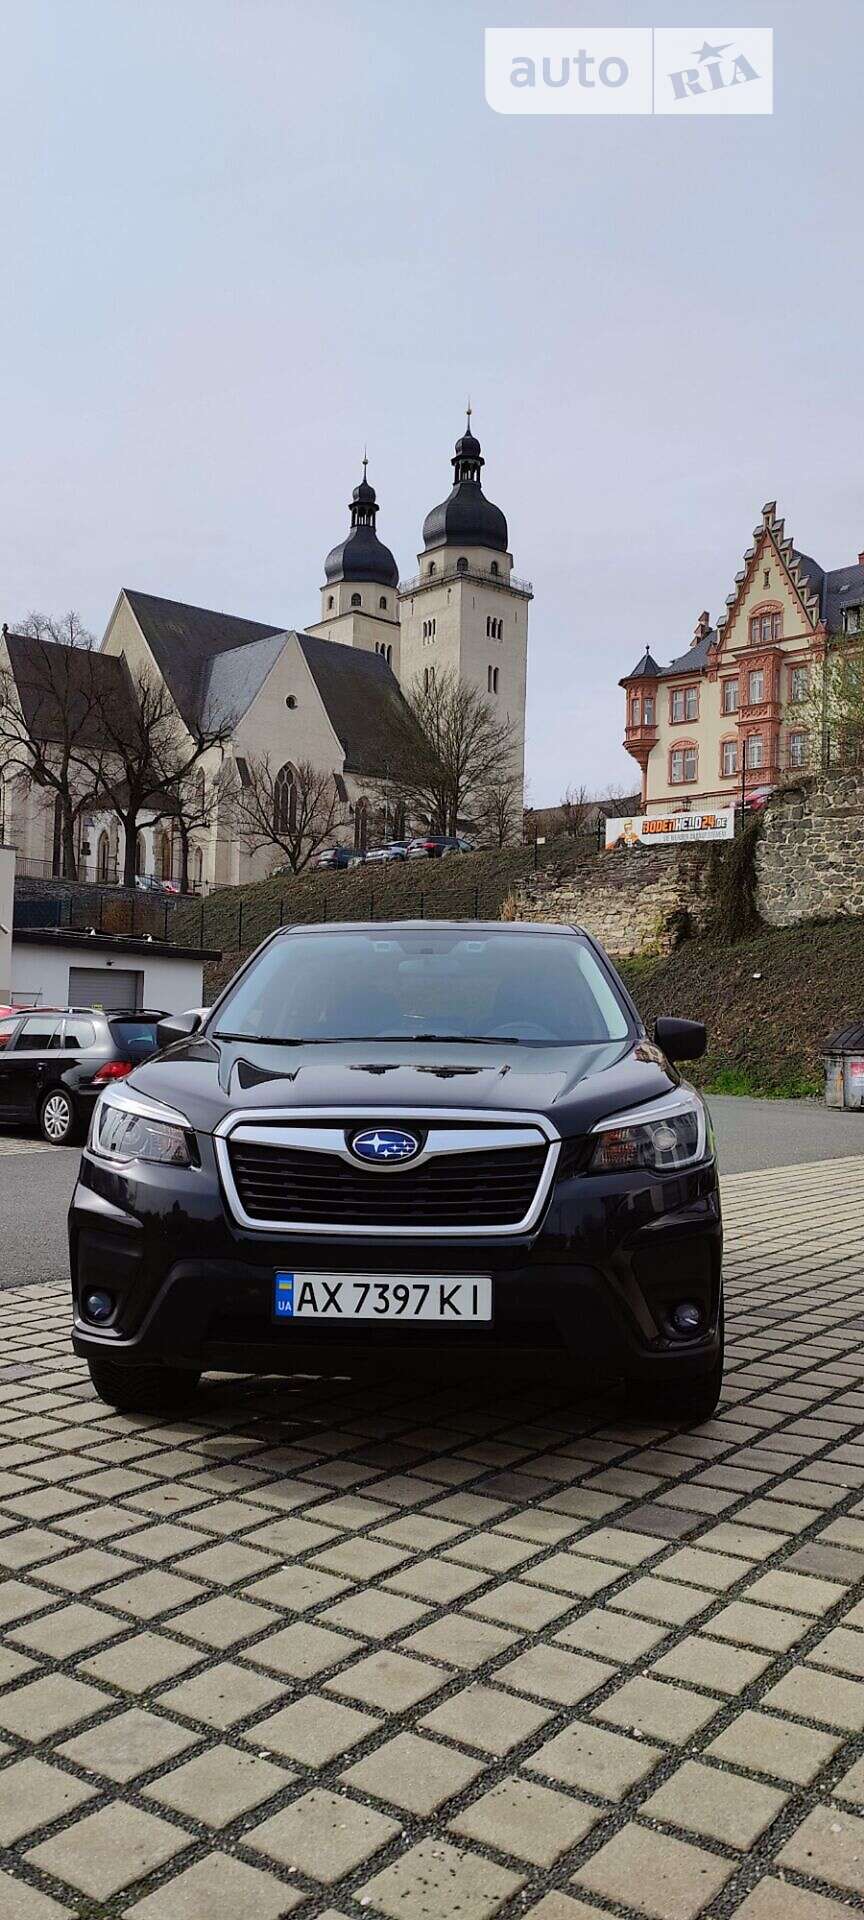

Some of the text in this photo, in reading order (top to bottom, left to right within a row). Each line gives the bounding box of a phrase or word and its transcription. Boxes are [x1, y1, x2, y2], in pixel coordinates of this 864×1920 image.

[278, 1301, 292, 1311] UA
[297, 1281, 343, 1313] AX
[352, 1283, 430, 1315] 7397
